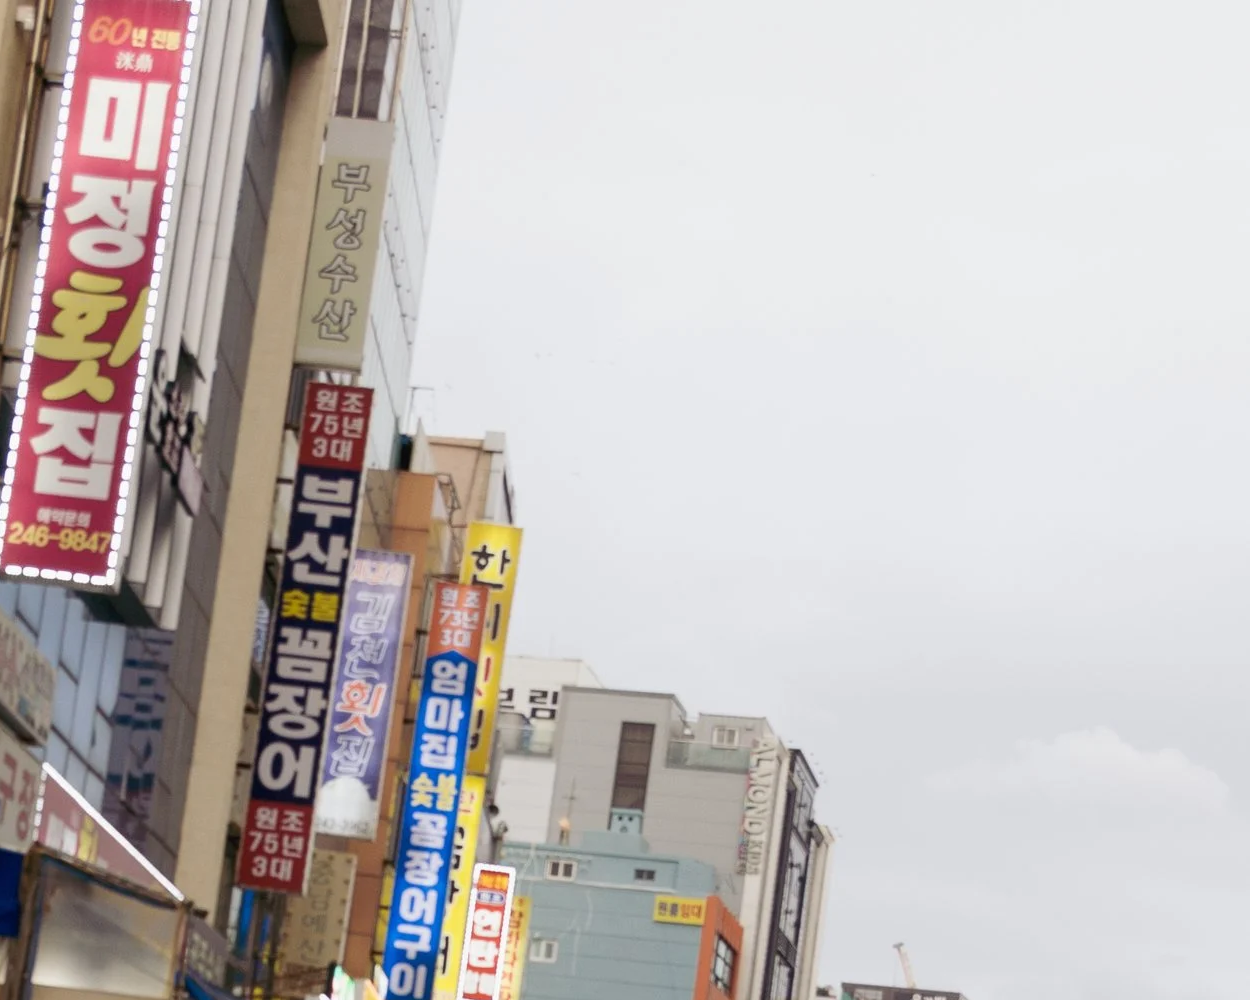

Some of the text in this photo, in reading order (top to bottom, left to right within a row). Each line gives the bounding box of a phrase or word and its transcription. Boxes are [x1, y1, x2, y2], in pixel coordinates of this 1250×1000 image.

[88, 16, 148, 48] 60년
[312, 162, 371, 342] 부성수산
[30, 77, 172, 501] 미정횟집
[315, 389, 365, 414] 원조
[310, 412, 365, 439] 75년
[311, 437, 354, 462] 3대
[287, 472, 352, 588] 부산
[280, 588, 340, 625] 숯불
[441, 587, 481, 609] 원조
[440, 629, 472, 649] 3대
[256, 626, 334, 801] 꼼장어
[420, 659, 469, 770] 엄마집
[410, 772, 459, 812] 숯불
[254, 806, 305, 833] 원조
[249, 832, 304, 859] 75년
[252, 856, 293, 881] 3대
